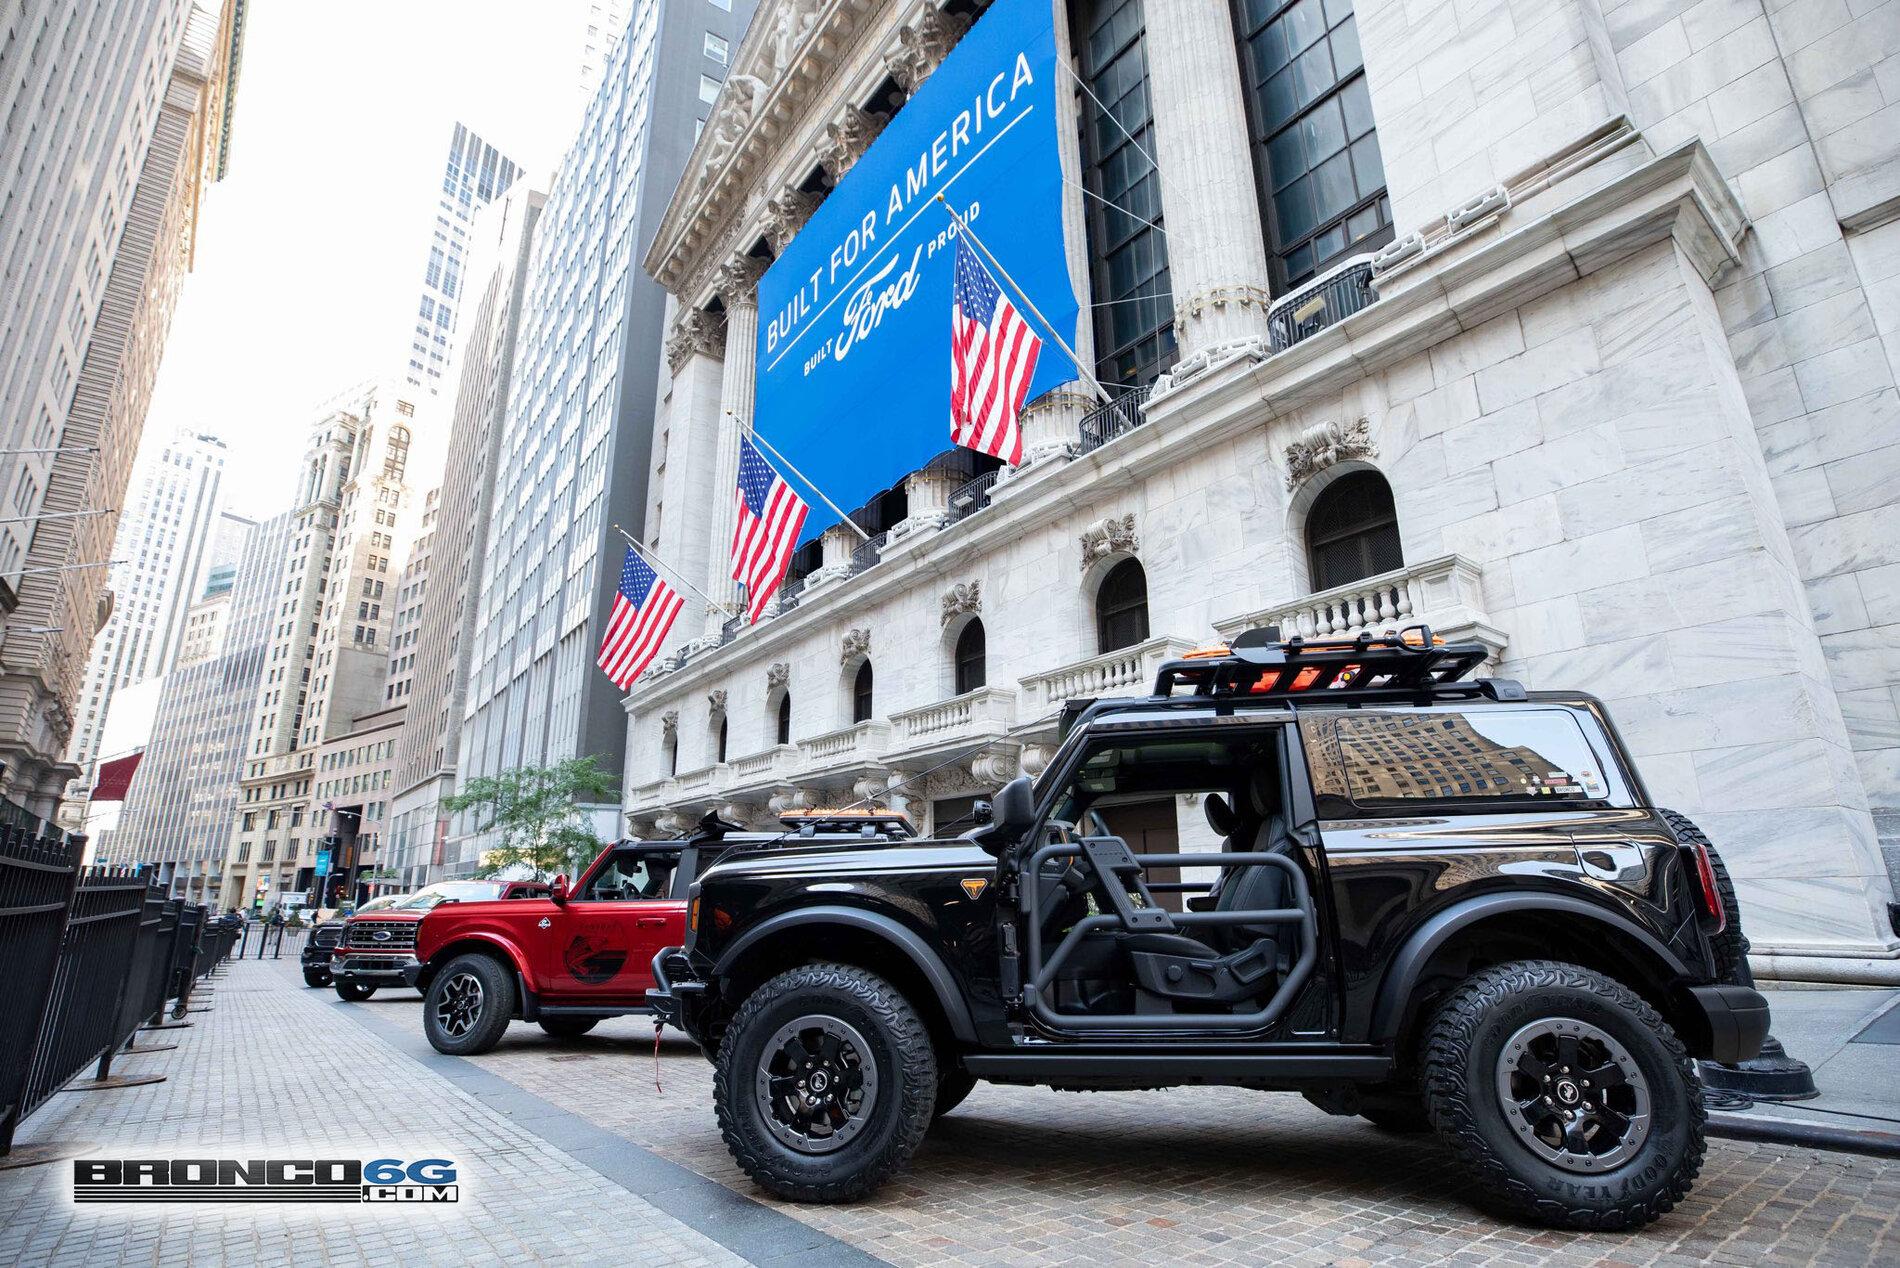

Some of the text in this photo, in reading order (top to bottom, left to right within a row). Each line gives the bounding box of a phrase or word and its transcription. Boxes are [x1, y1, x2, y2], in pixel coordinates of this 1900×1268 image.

[767, 51, 1034, 353] BUILT FOR AMERICA
[803, 201, 980, 377] BUILT Ford PROUD
